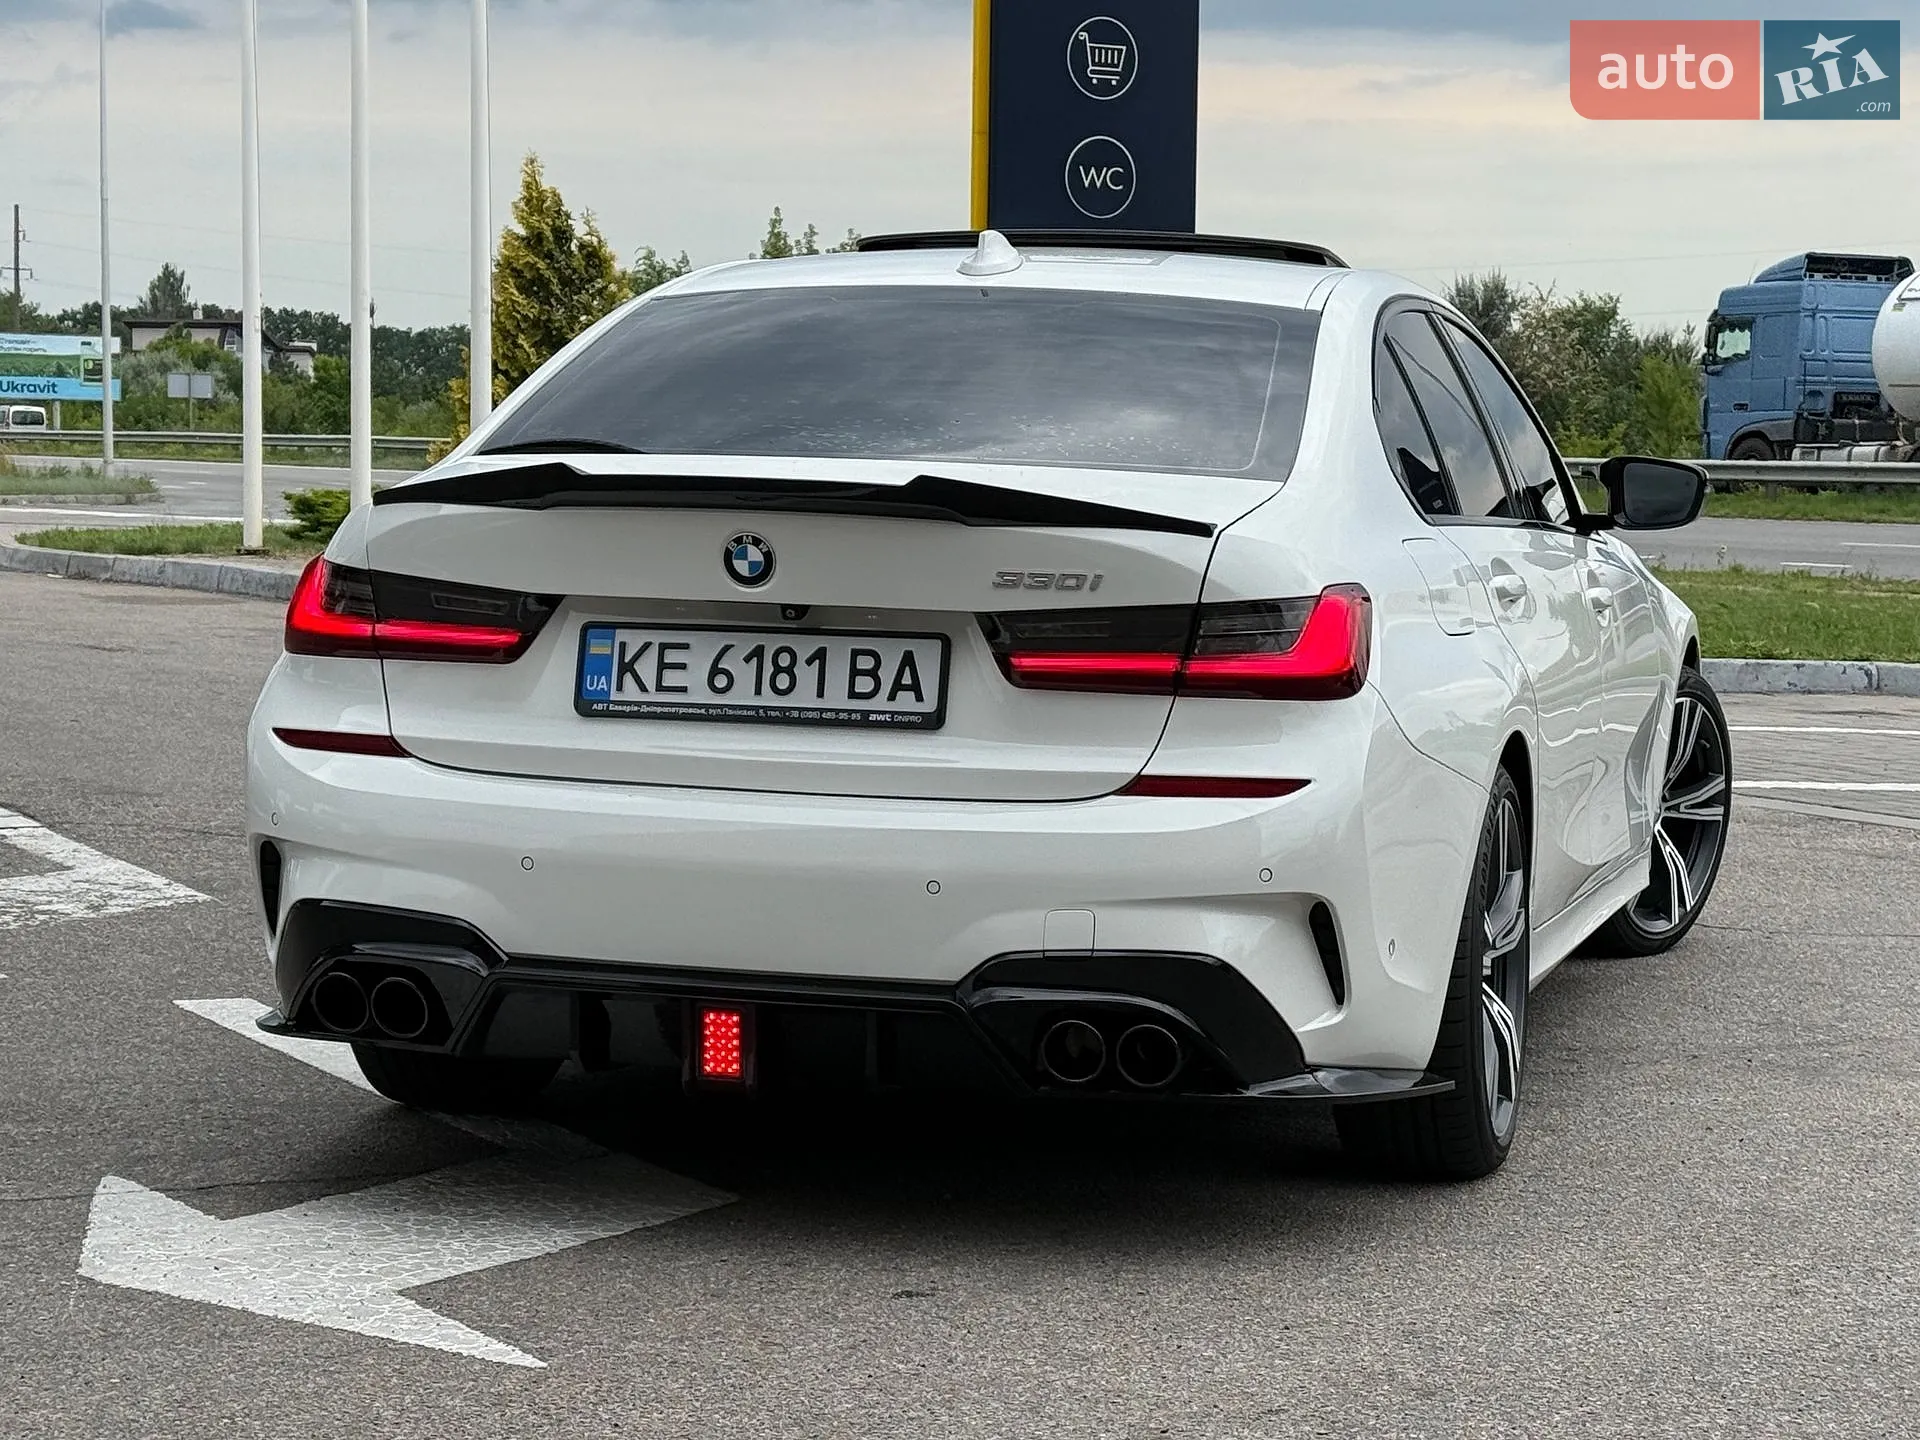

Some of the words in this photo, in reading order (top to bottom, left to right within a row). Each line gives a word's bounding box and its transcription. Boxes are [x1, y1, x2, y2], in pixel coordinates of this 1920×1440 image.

[1079, 165, 1124, 190] WC
[0, 380, 58, 394] Ukravit
[727, 535, 769, 553] BMW
[991, 571, 1104, 592] 330i
[616, 640, 690, 693] KE
[707, 643, 828, 698] 6181
[847, 648, 924, 702] BA
[586, 675, 608, 691] UA
